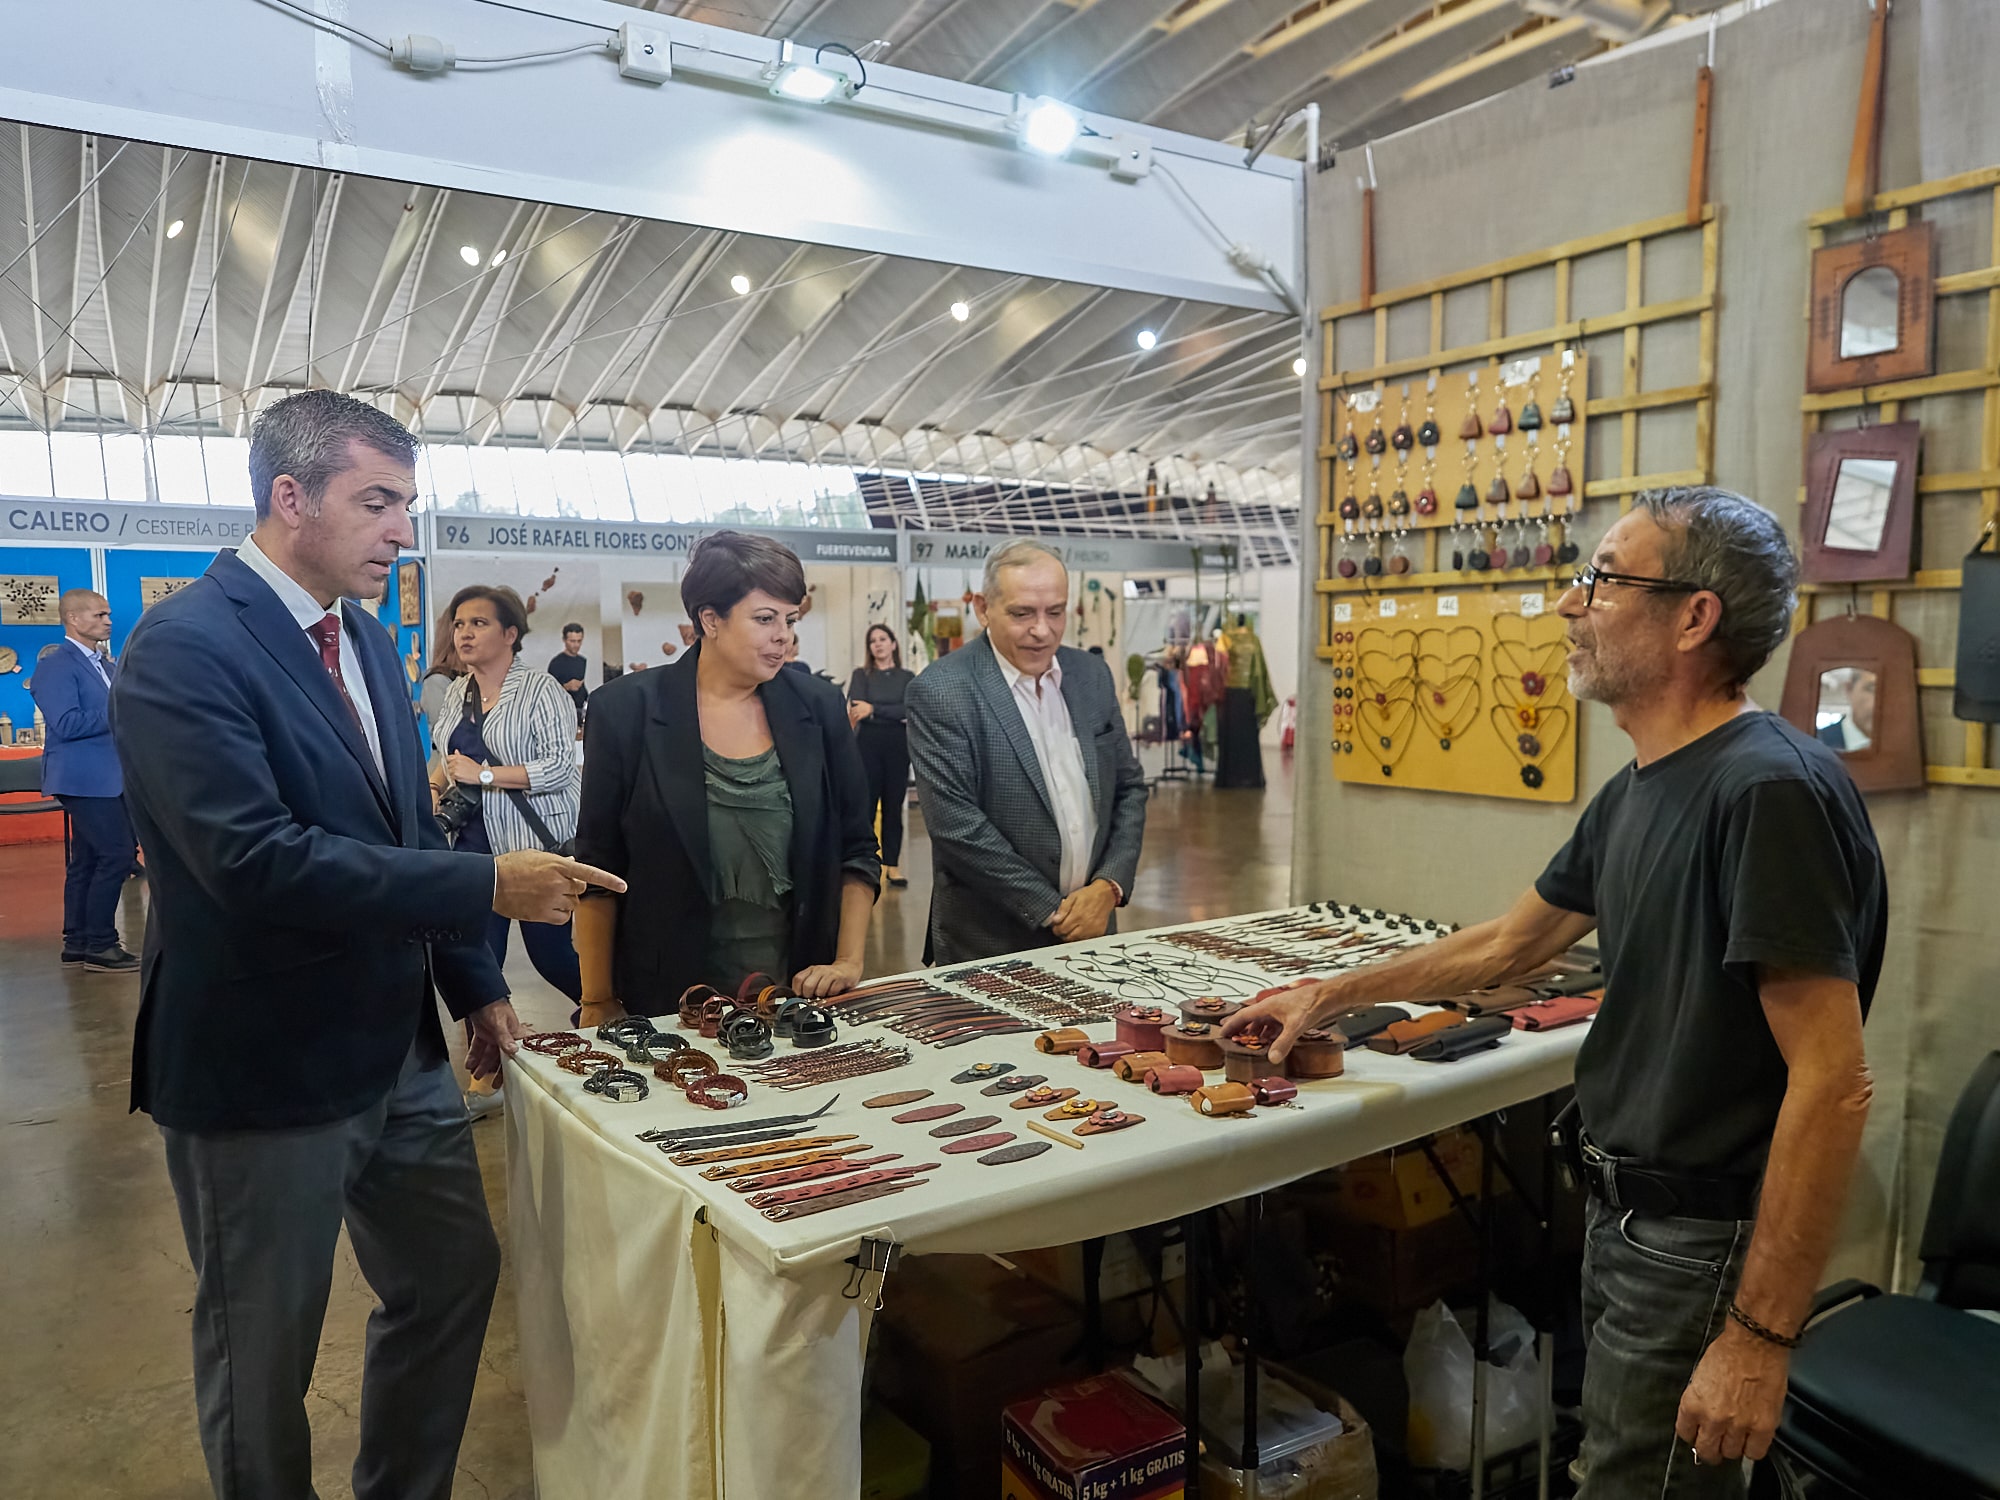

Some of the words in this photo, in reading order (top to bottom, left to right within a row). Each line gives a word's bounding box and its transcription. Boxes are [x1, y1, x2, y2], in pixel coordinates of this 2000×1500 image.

[8, 509, 110, 533] CALERO
[118, 513, 128, 536] /
[136, 516, 213, 537] CESTERÍA
[218, 522, 240, 537] DE
[446, 525, 470, 544] 96
[488, 523, 528, 546] JOSÉ
[533, 529, 590, 548] RAFAEL
[594, 531, 647, 550] FLORES
[816, 543, 891, 557] FUERTEVENTURA
[916, 543, 934, 558] 97
[1012, 1434, 1021, 1459] kg
[1032, 1456, 1041, 1480] kg
[1042, 1468, 1074, 1500] GRATIS
[1082, 1486, 1091, 1500] 5
[1093, 1481, 1109, 1499] kg
[1120, 1471, 1127, 1488] 1
[1130, 1467, 1145, 1485] kg
[1146, 1449, 1186, 1477] GRATIS
